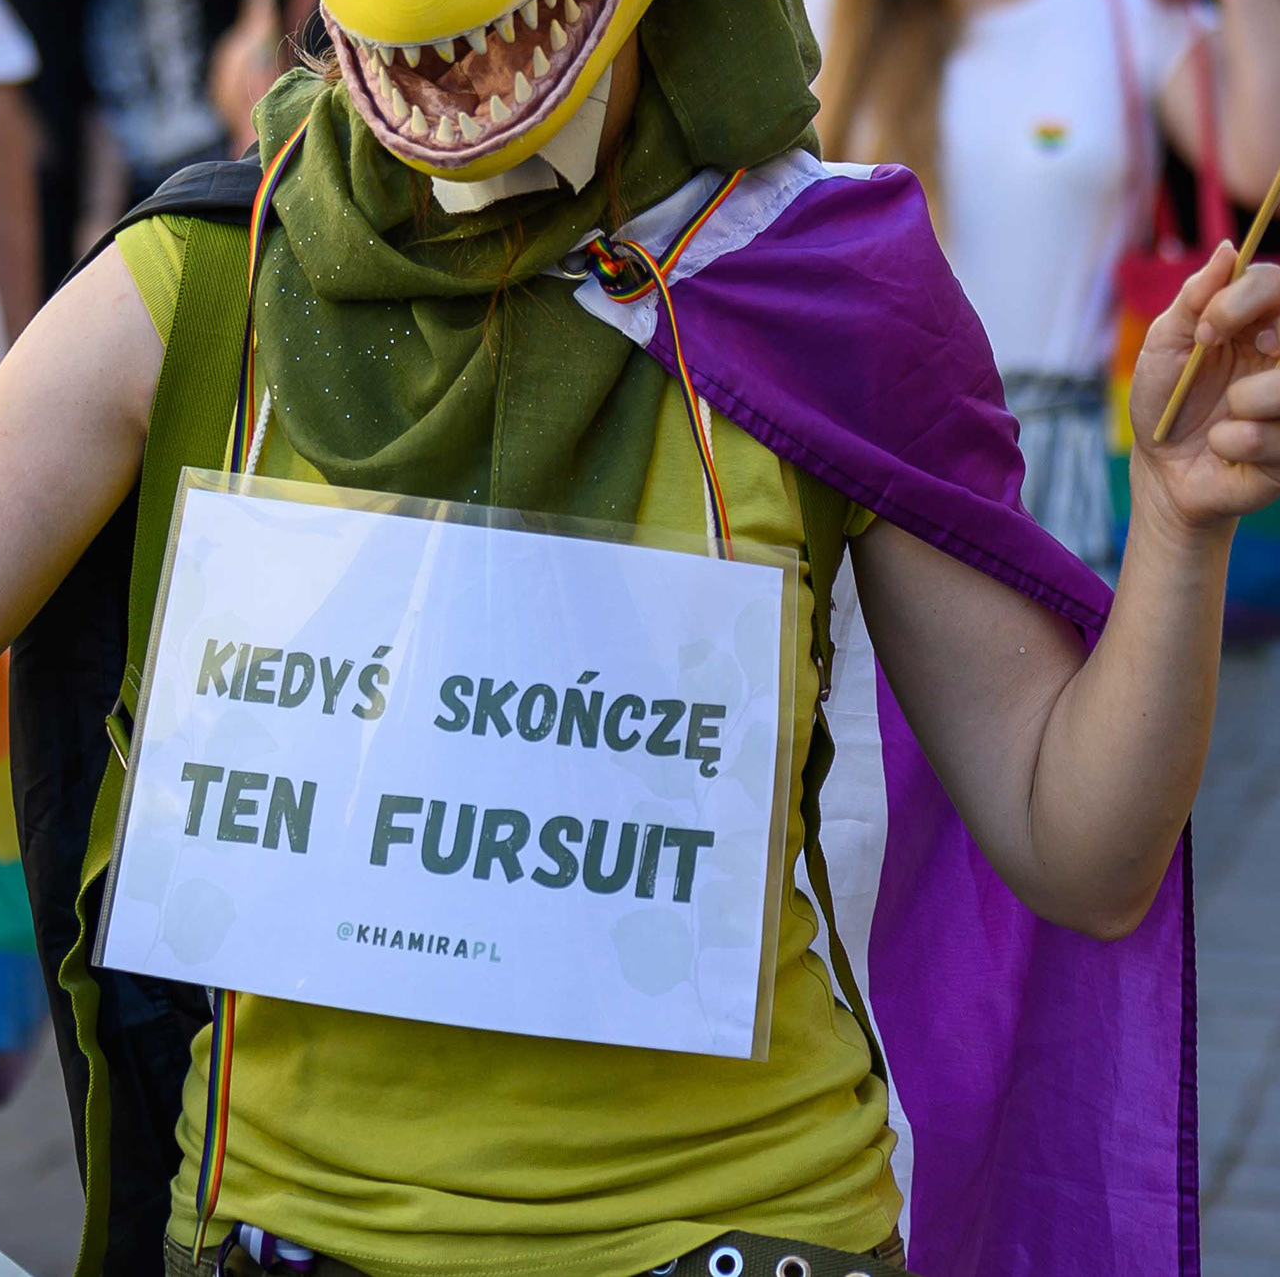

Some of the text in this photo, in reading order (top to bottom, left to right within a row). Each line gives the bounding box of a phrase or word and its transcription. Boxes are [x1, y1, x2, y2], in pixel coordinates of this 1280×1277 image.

[196, 639, 727, 778] KIEDYŚ SKOŃCZĘ
[181, 762, 715, 903] TEN FURSUIT
[336, 921, 502, 963] @KHAMIRAPL
